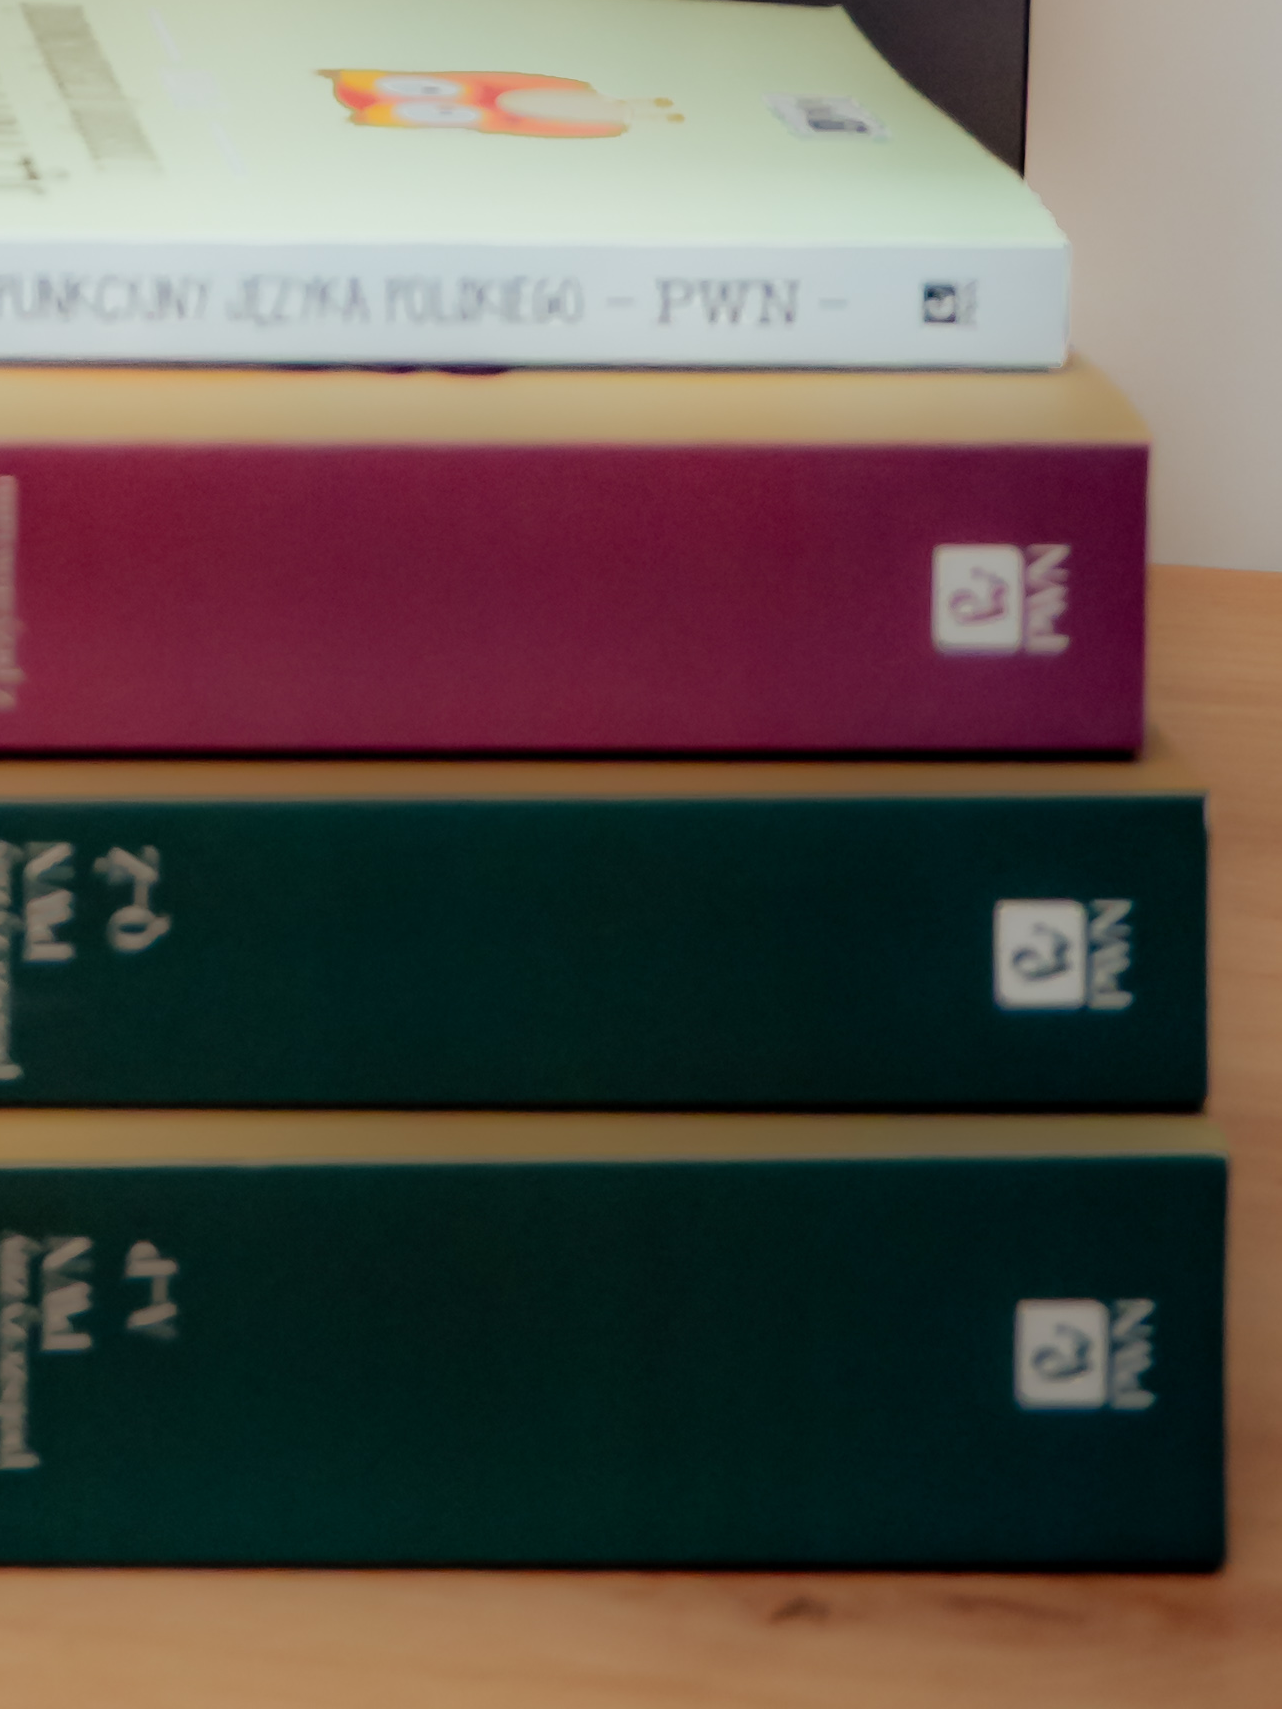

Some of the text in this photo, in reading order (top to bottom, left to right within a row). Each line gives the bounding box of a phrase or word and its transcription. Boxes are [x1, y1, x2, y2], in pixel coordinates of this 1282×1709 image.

[656, 277, 800, 325] PWN
[1026, 543, 1070, 653] PWN
[24, 842, 76, 961] PWN
[1090, 898, 1134, 1009] PWN
[40, 1236, 94, 1351] PWN
[1112, 1298, 1156, 1411] PWN
